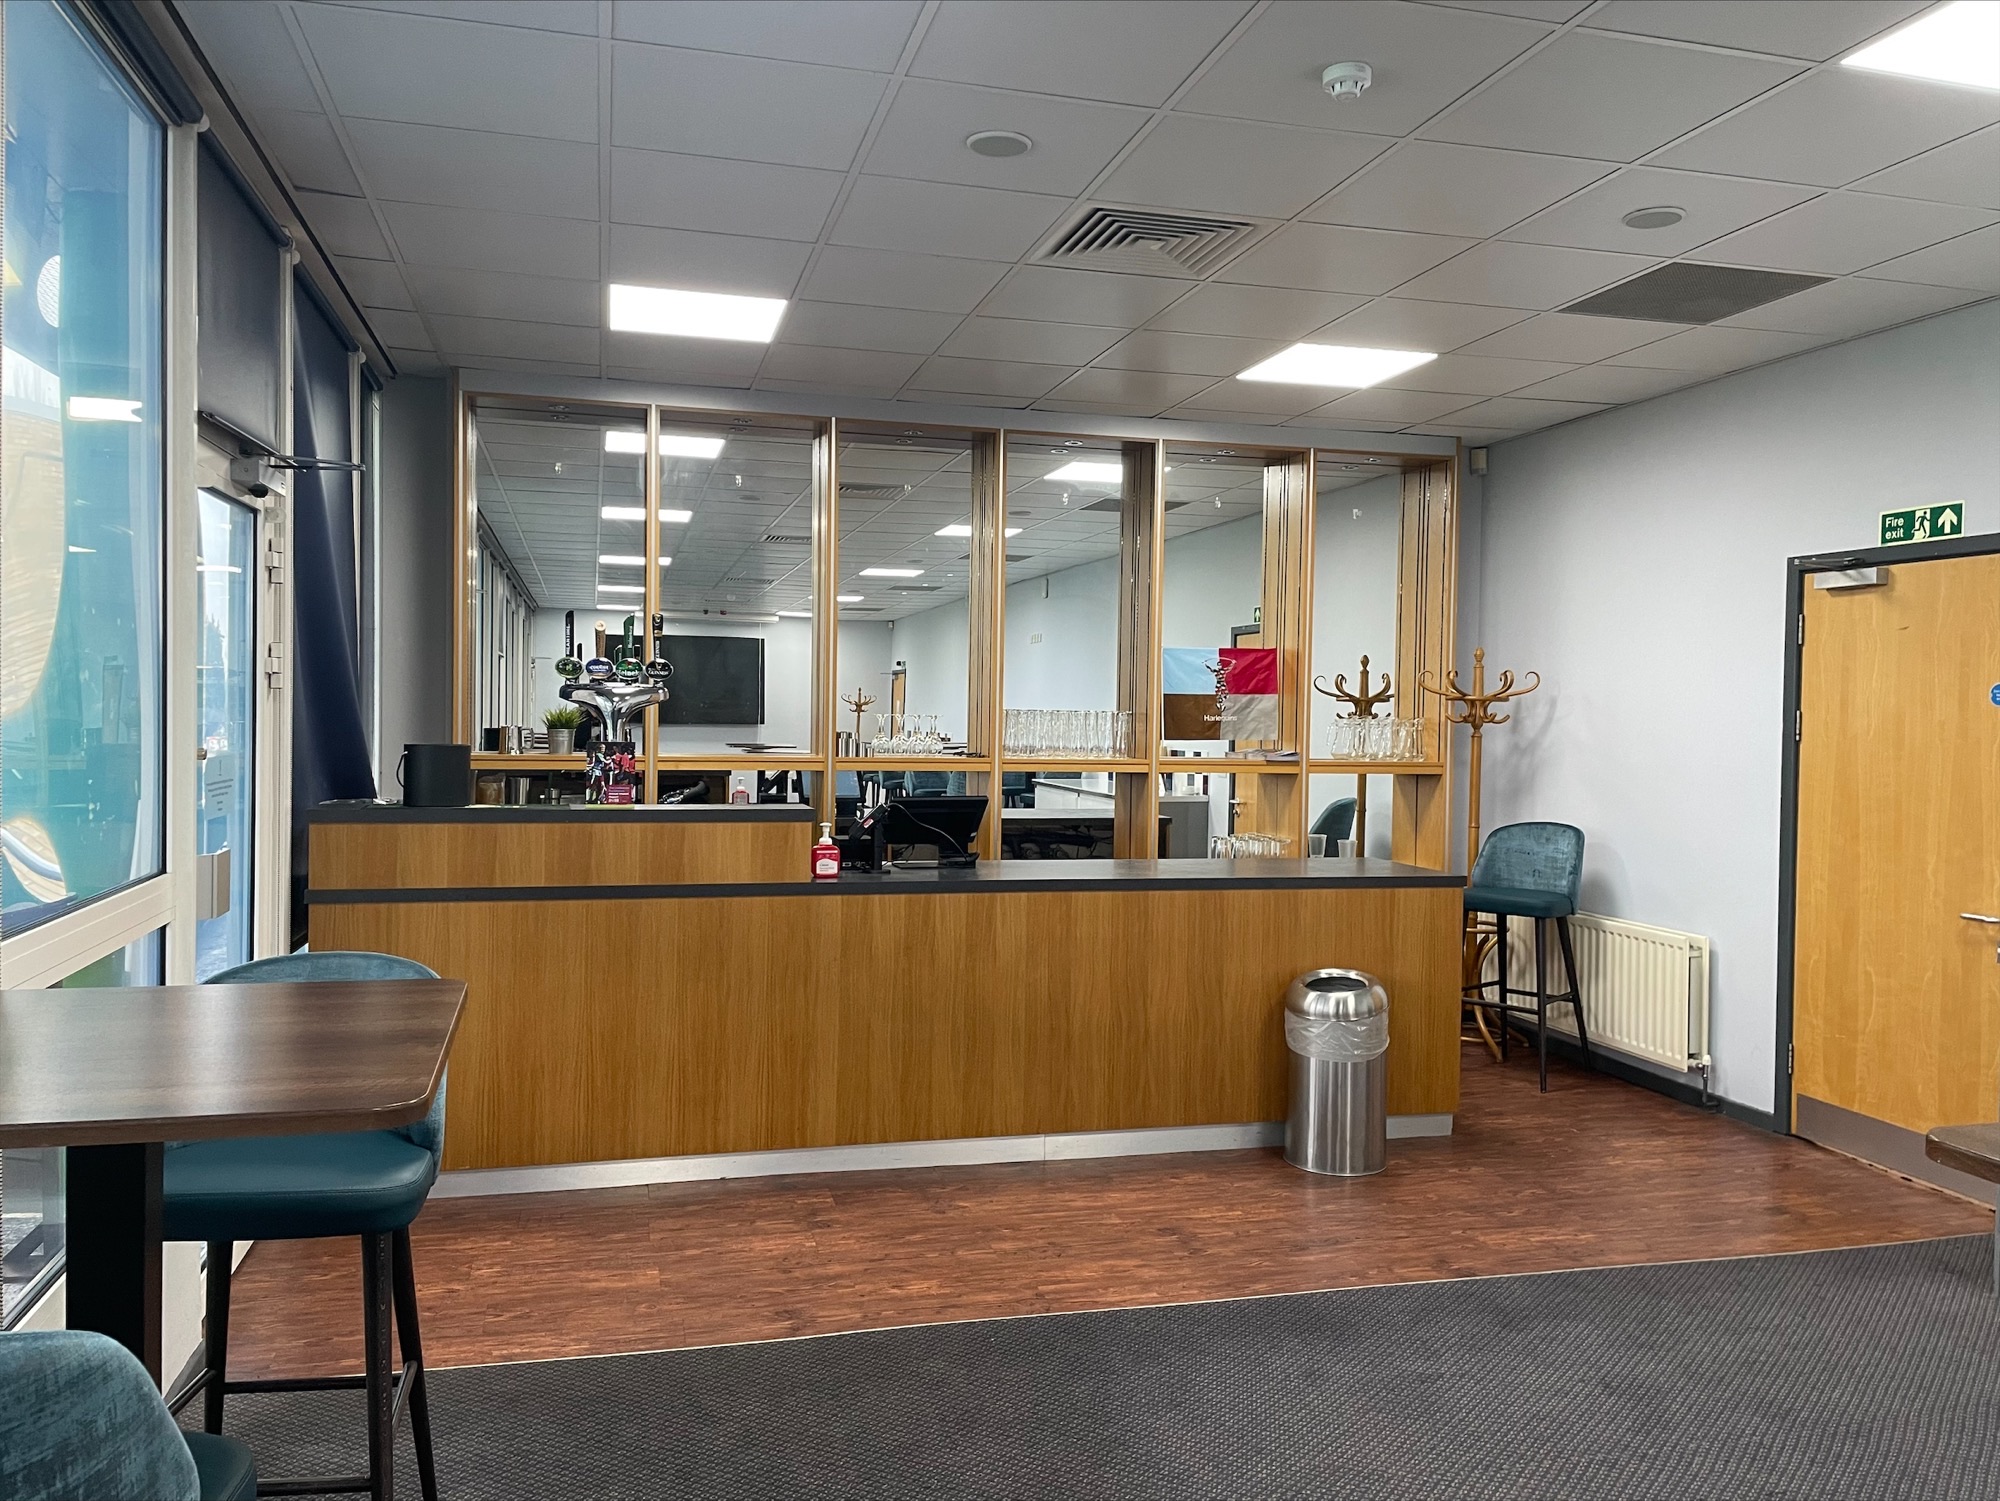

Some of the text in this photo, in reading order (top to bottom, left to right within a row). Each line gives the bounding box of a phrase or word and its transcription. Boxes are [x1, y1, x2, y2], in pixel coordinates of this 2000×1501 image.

[1885, 516, 1904, 528] Fire
[1885, 528, 1904, 539] exit
[1203, 714, 1238, 722] Harlequins
